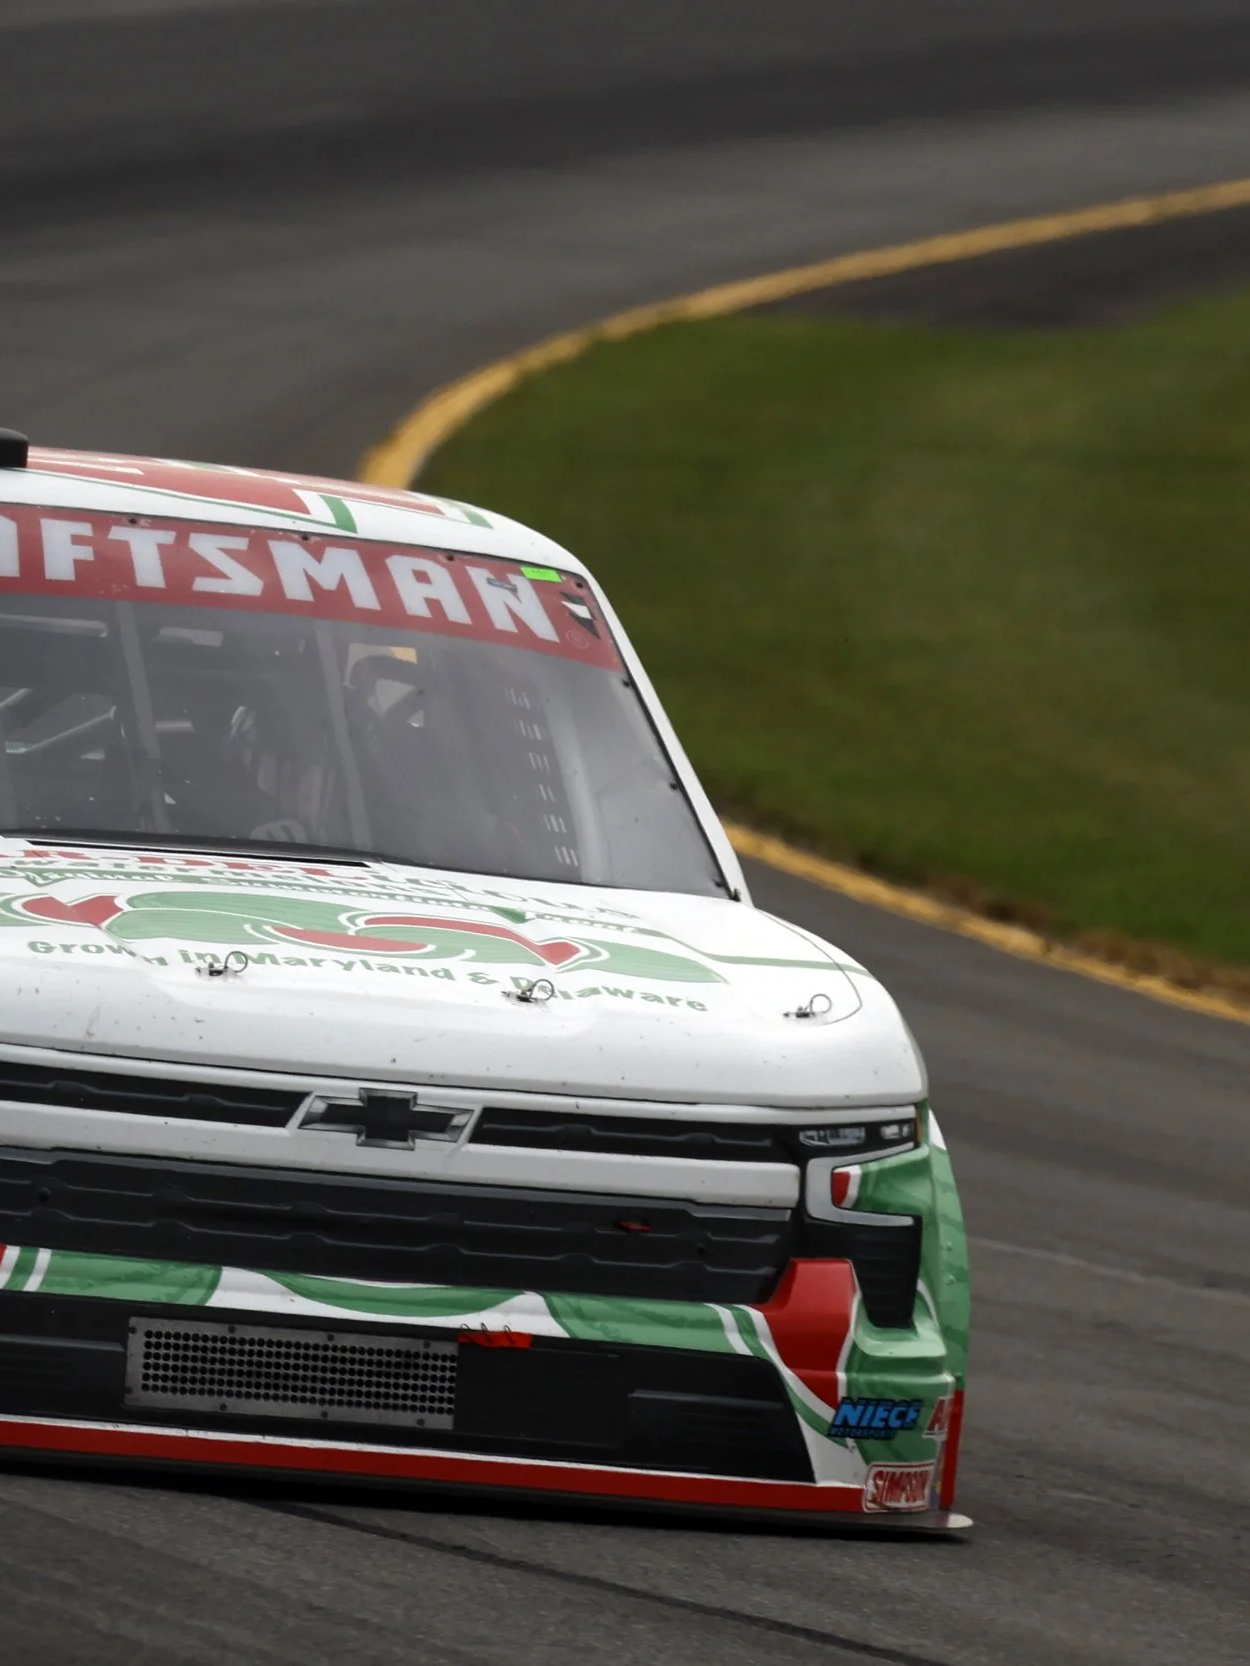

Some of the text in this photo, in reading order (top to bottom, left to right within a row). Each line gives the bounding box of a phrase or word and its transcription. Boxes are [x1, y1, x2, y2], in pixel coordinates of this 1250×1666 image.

[28, 940, 168, 967] Grown
[179, 949, 217, 964] in
[244, 951, 456, 981] Maryland
[470, 970, 498, 985] &
[833, 1399, 922, 1429] NIECE
